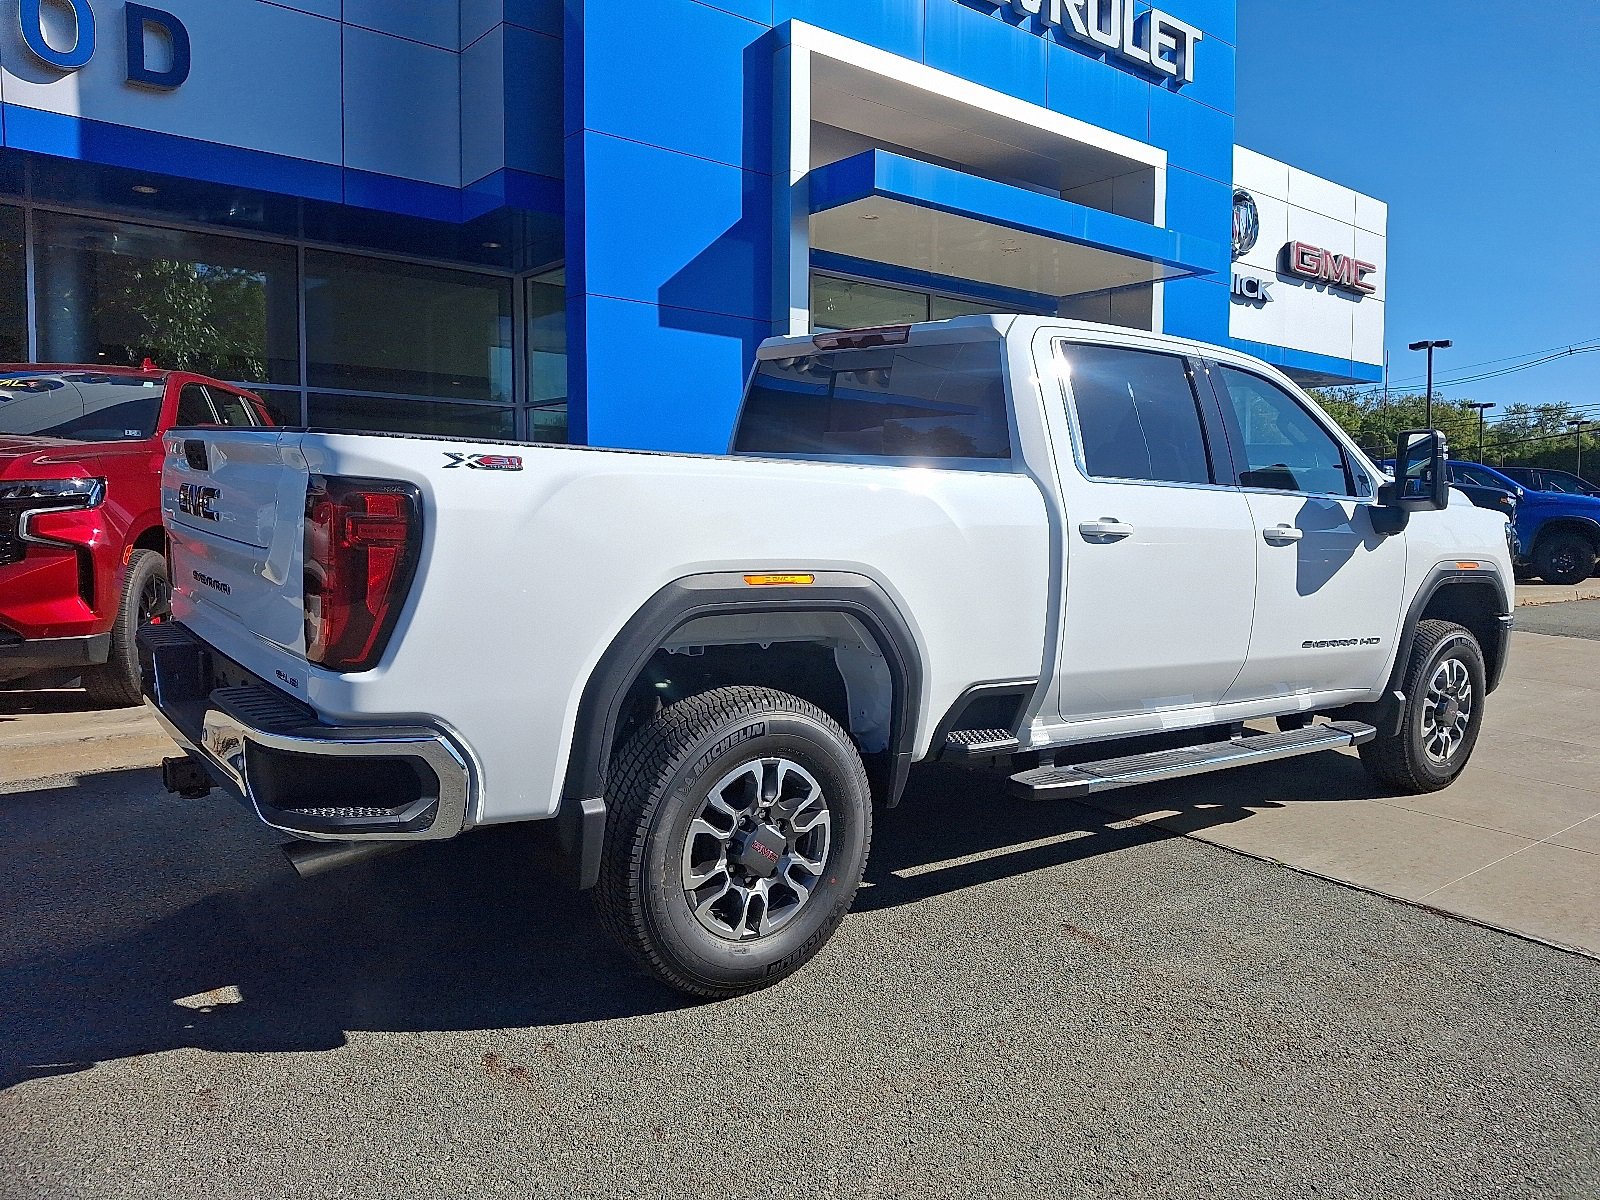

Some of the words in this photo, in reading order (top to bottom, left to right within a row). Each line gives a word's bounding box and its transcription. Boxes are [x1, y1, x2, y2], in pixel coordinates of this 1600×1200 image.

[1293, 240, 1377, 294] GMC
[1302, 638, 1359, 648] SIERRA
[1359, 637, 1381, 645] HD
[693, 721, 765, 777] MICHELIN
[751, 840, 779, 863] GMC
